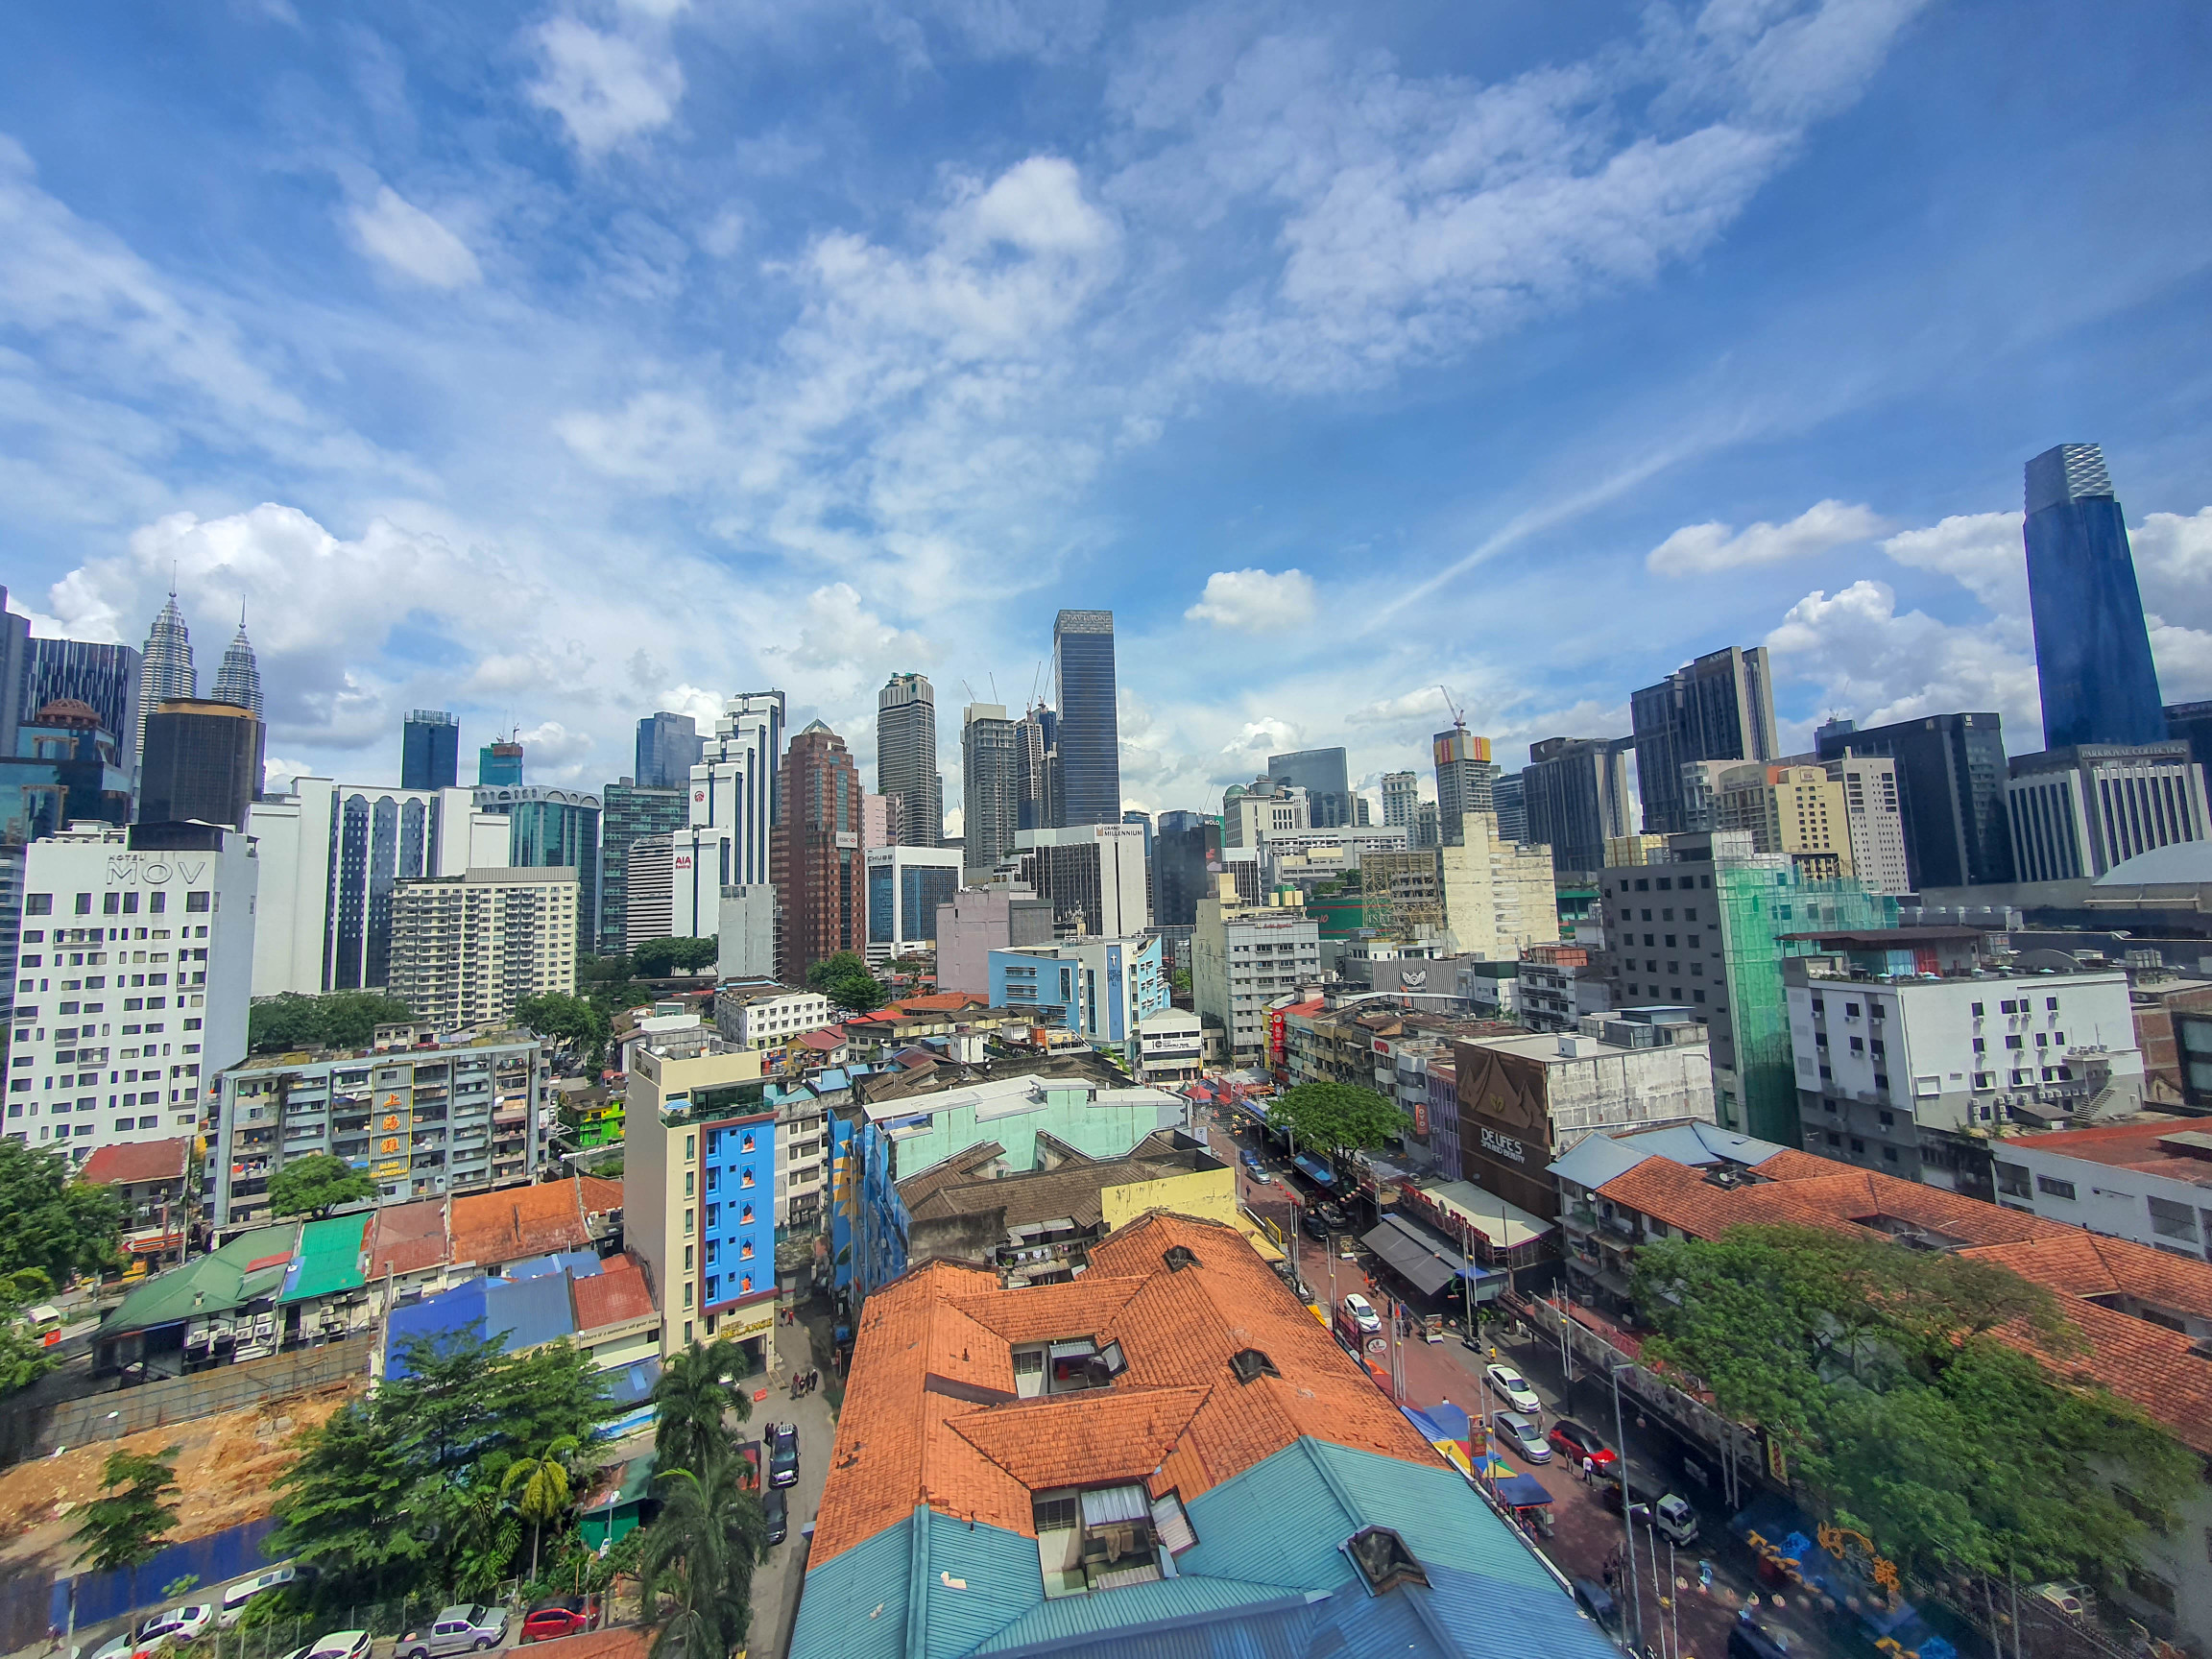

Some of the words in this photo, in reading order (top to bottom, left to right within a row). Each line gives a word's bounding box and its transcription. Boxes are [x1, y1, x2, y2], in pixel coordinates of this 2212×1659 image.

[1067, 613, 1106, 622] PAVILION
[1709, 649, 1732, 661] AXON
[2081, 748, 2129, 757] PARKROYAL
[2131, 746, 2187, 756] COLLECTION
[108, 853, 145, 861] HOTEL
[675, 855, 691, 864] AIA
[867, 854, 893, 862] CHUBB
[107, 861, 206, 885] MOV
